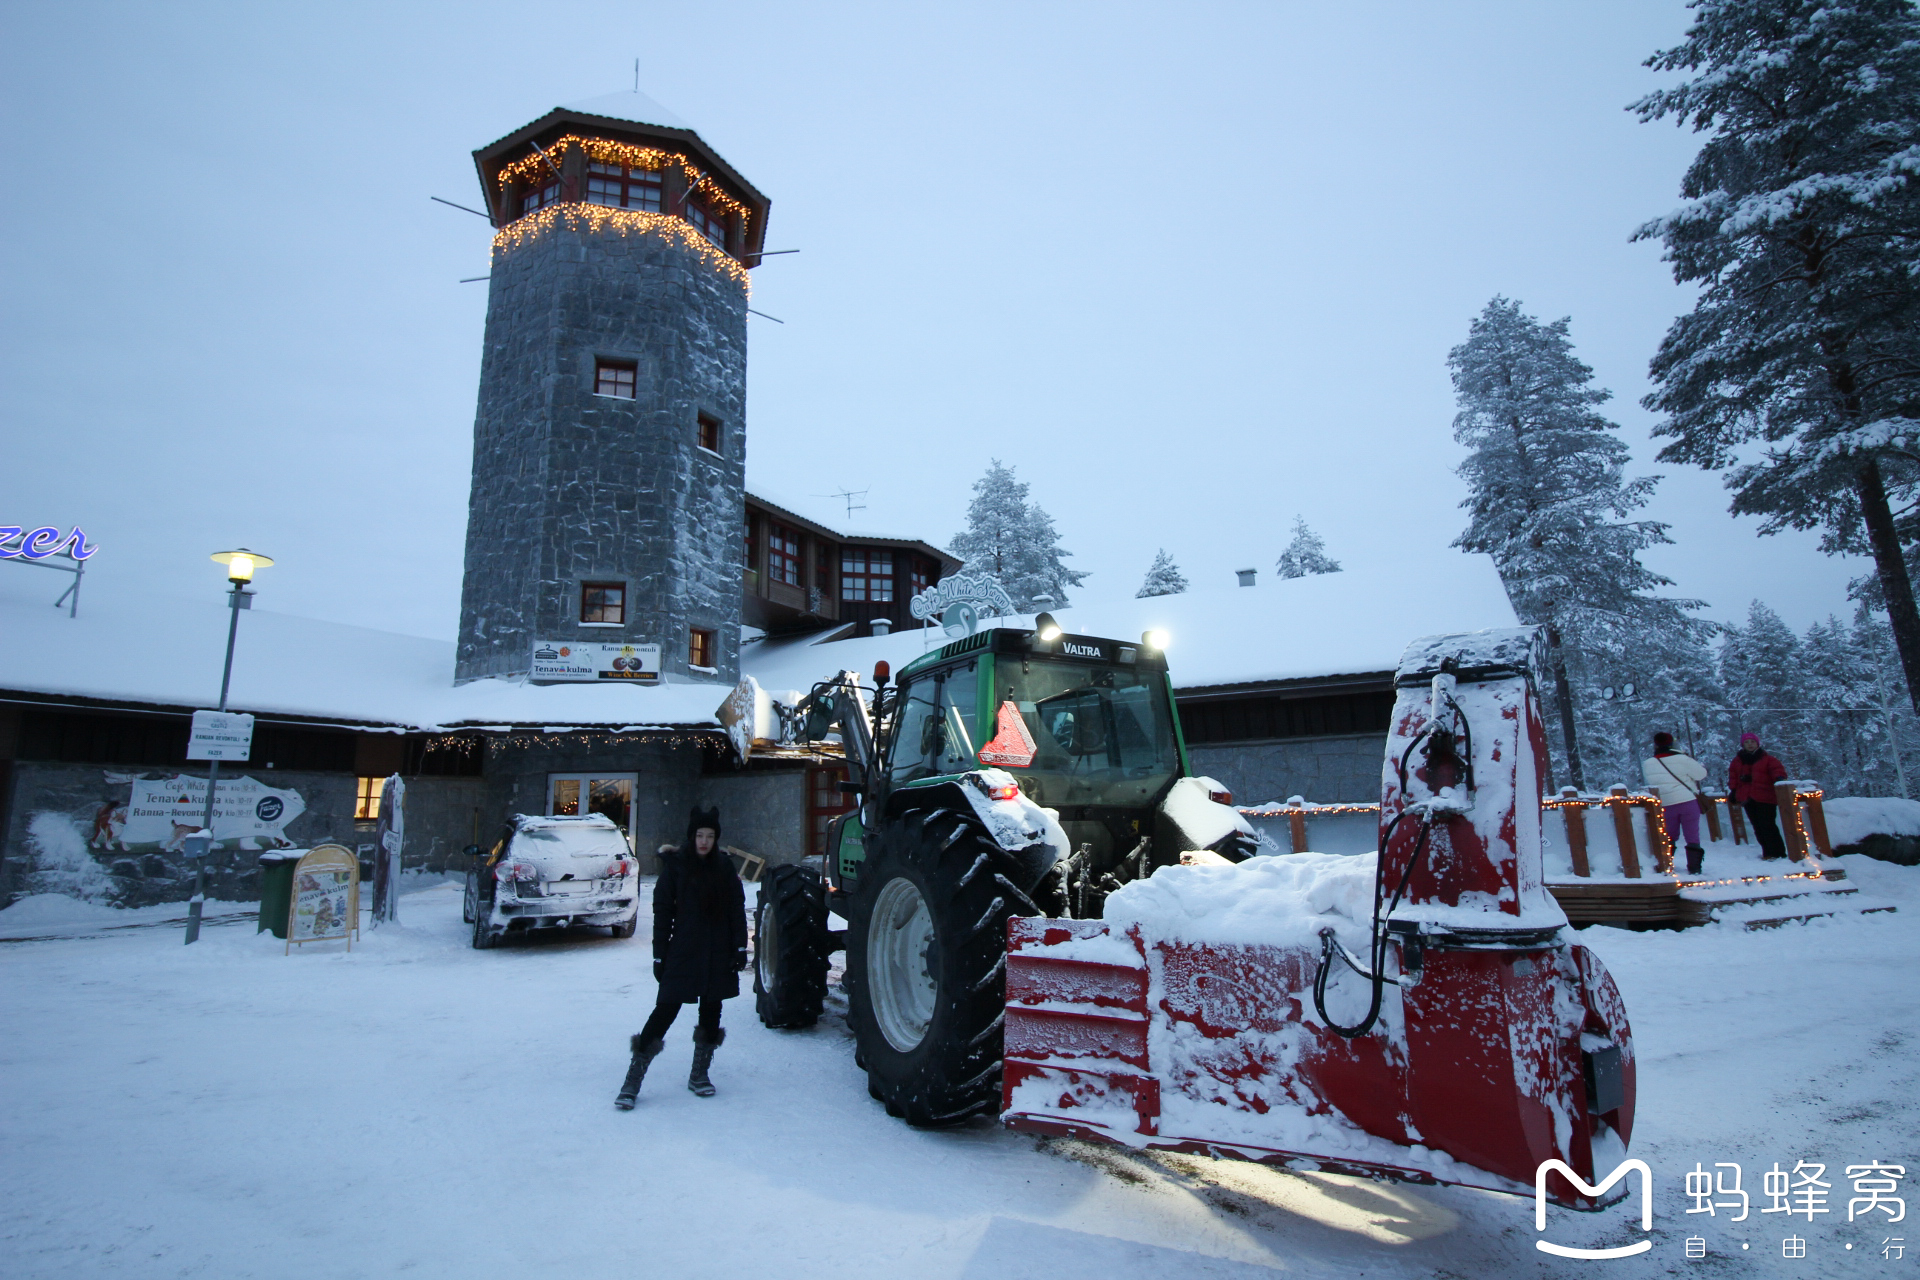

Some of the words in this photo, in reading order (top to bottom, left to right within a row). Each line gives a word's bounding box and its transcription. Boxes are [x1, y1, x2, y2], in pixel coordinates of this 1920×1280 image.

[939, 577, 974, 598] White
[976, 578, 1008, 607] Swan
[1062, 641, 1101, 657] VALTRA
[623, 668, 633, 678] &
[187, 779, 205, 791] White
[213, 809, 223, 818] Oy
[259, 800, 282, 817] Fazer
